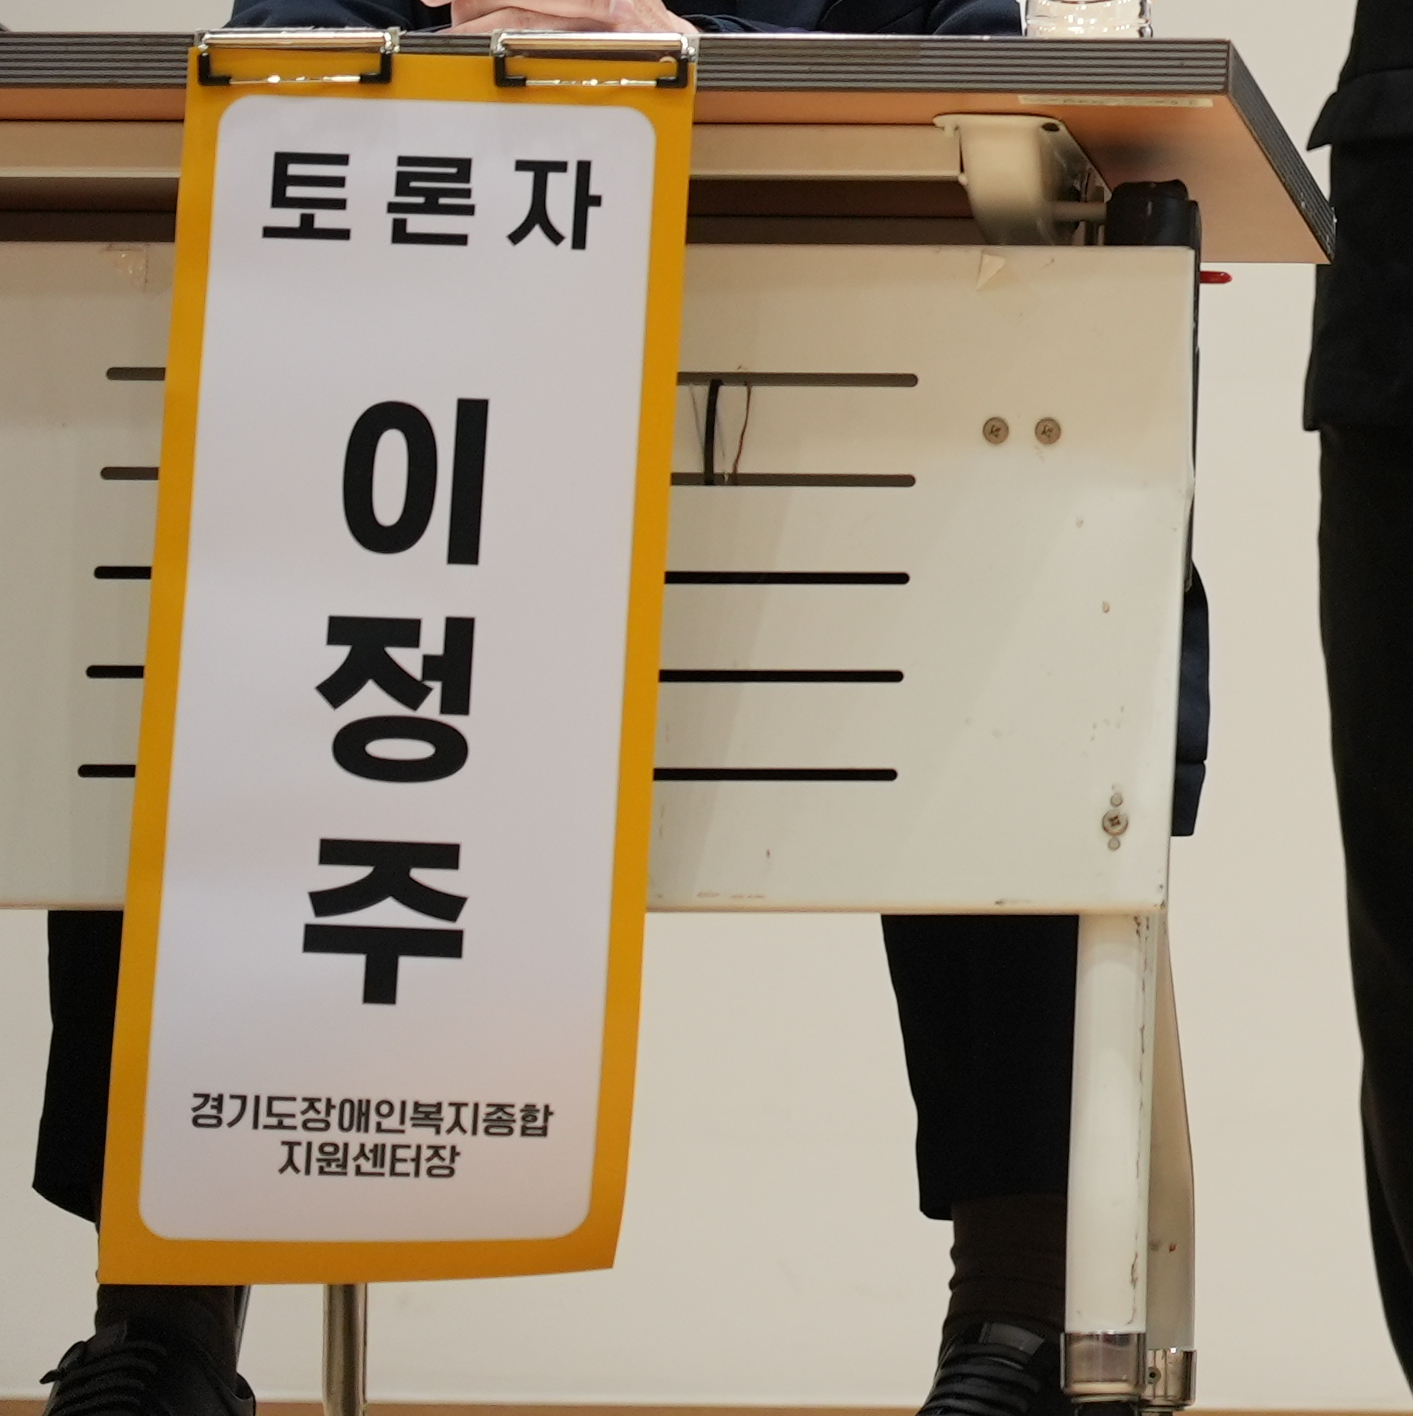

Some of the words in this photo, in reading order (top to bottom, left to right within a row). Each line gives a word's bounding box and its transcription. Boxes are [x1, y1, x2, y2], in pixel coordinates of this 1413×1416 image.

[261, 151, 603, 251] 토론자
[302, 397, 490, 1006] 이정주
[190, 1092, 555, 1138] 경기도장애인복지종합
[277, 1139, 461, 1179] 지원센터장
